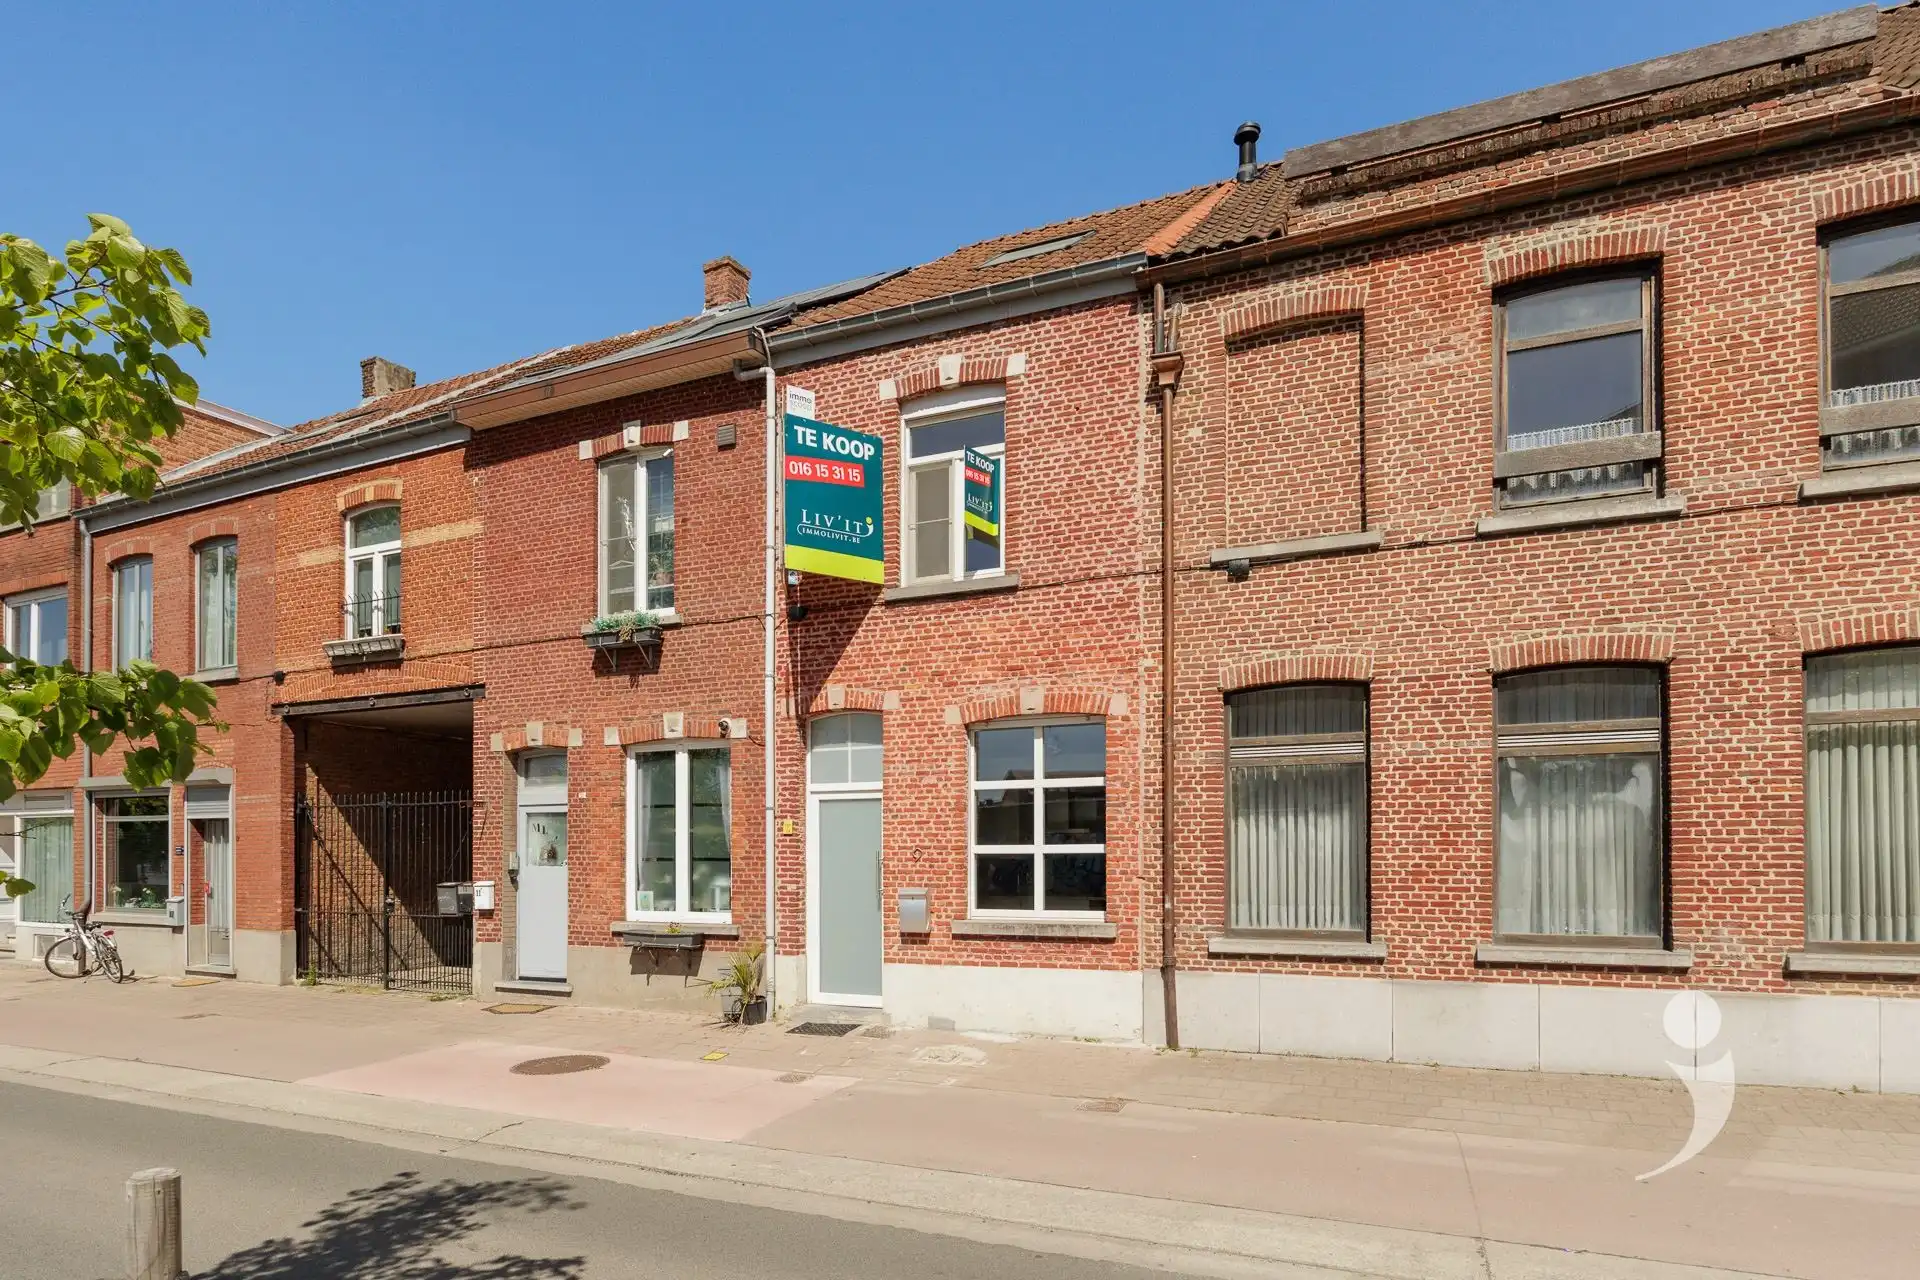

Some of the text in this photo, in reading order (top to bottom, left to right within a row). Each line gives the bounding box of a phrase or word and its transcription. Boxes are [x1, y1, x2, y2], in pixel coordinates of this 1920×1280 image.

[790, 390, 812, 405] immo
[794, 425, 875, 460] TE KOOP
[789, 461, 861, 482] 016 15 31 15
[966, 451, 995, 473] TE KOOP
[802, 527, 860, 544] IMMOLIVIT.BE
